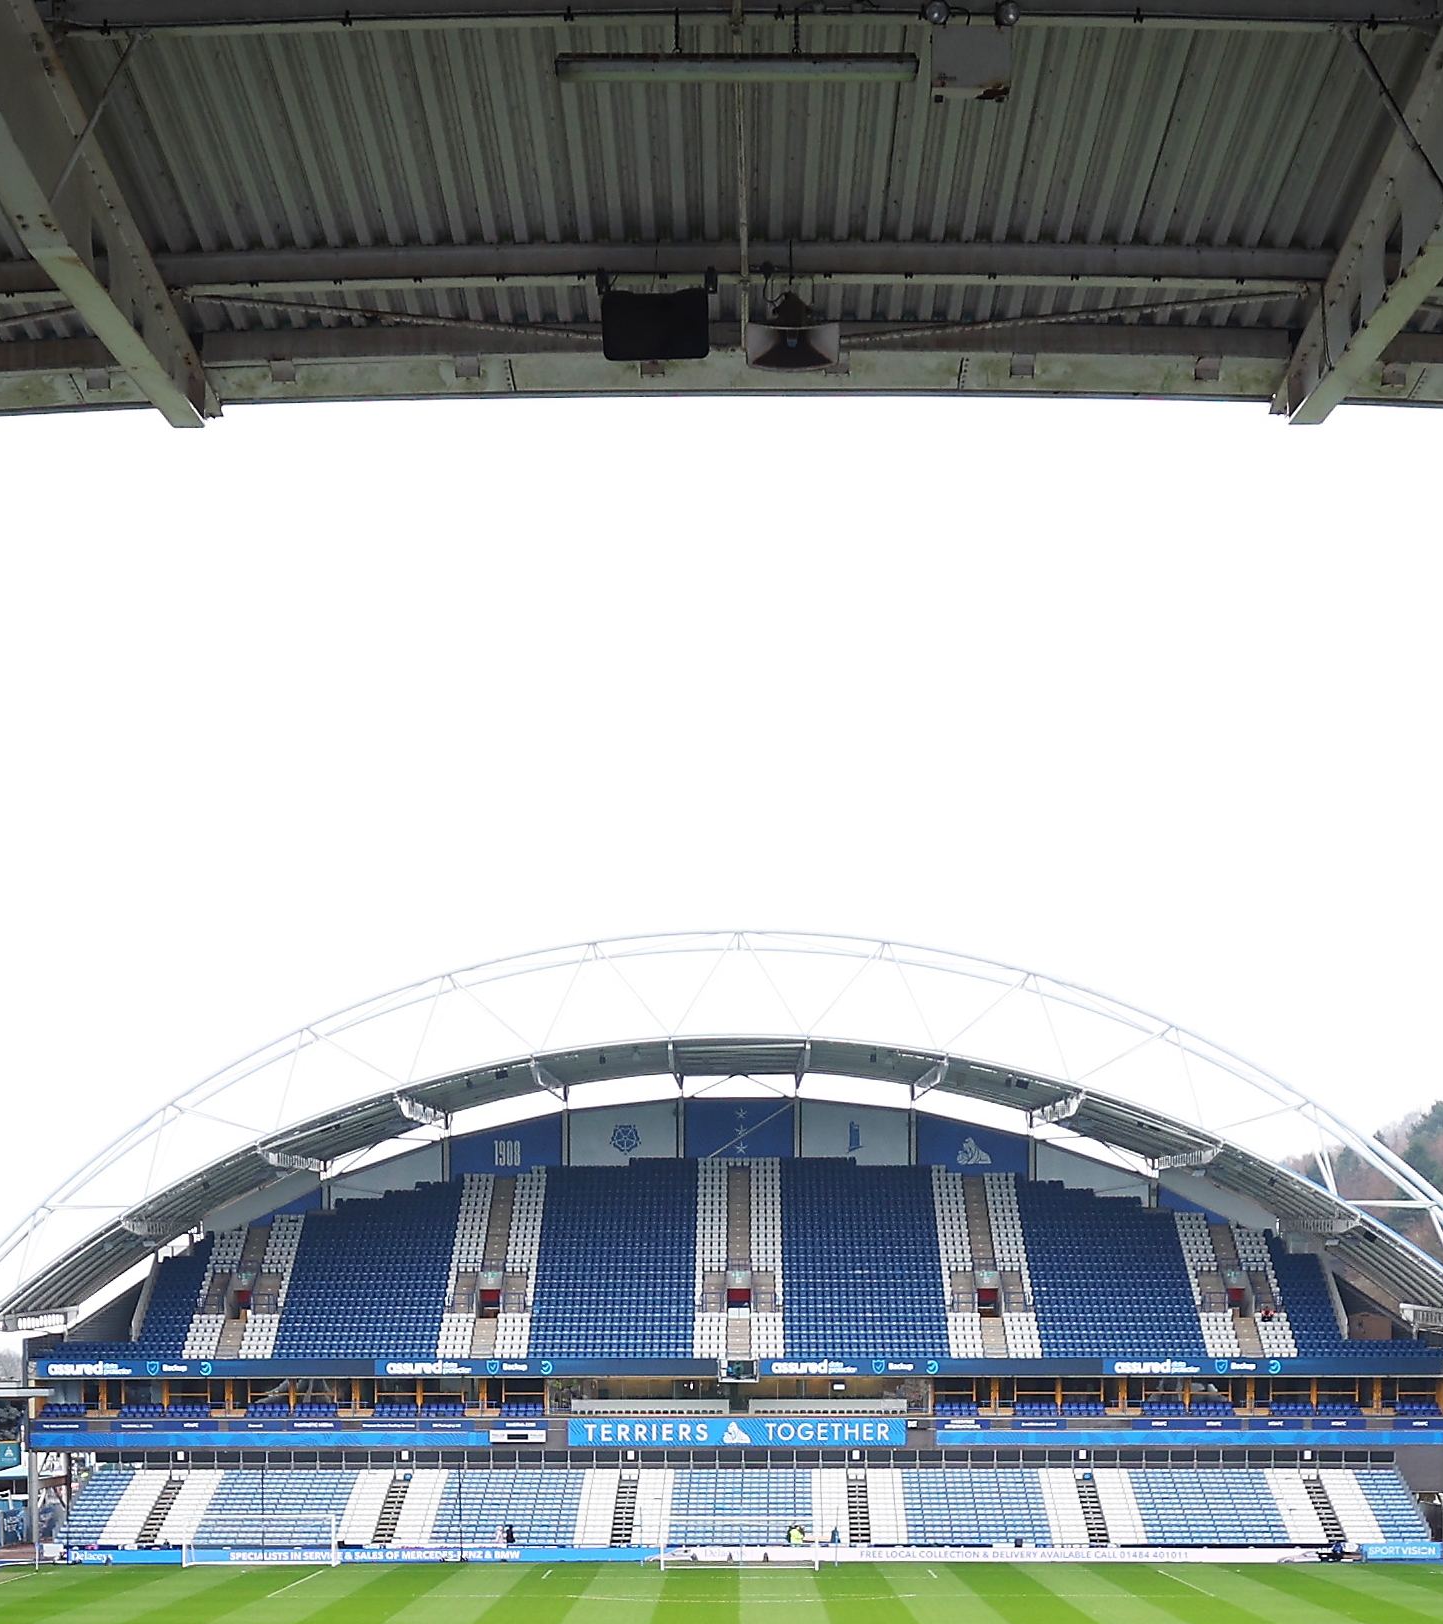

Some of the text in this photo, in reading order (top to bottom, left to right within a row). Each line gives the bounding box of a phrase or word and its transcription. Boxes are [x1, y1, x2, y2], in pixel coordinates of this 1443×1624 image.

[493, 1140, 521, 1166] 1908
[48, 1360, 103, 1376] assured
[386, 1360, 442, 1375] assured
[772, 1359, 828, 1374] assured
[1114, 1359, 1170, 1374] assured
[584, 1423, 708, 1442] TERRIERS
[765, 1422, 889, 1441] TOGETHER
[71, 1550, 113, 1563] Delaceys
[230, 1551, 289, 1561] SPECIALISTS
[291, 1551, 301, 1561] IN
[303, 1551, 343, 1561] SERVICE
[344, 1551, 353, 1561] &
[355, 1551, 383, 1561] SALES
[386, 1551, 400, 1561] OF
[484, 1551, 493, 1561] &
[494, 1551, 520, 1561] BMW
[860, 1550, 1188, 1559] FREE LOCAL COLLECTION & DELIVERY AVAILABLE CALL 01484 401011
[1368, 1545, 1436, 1556] SPORT VISION
